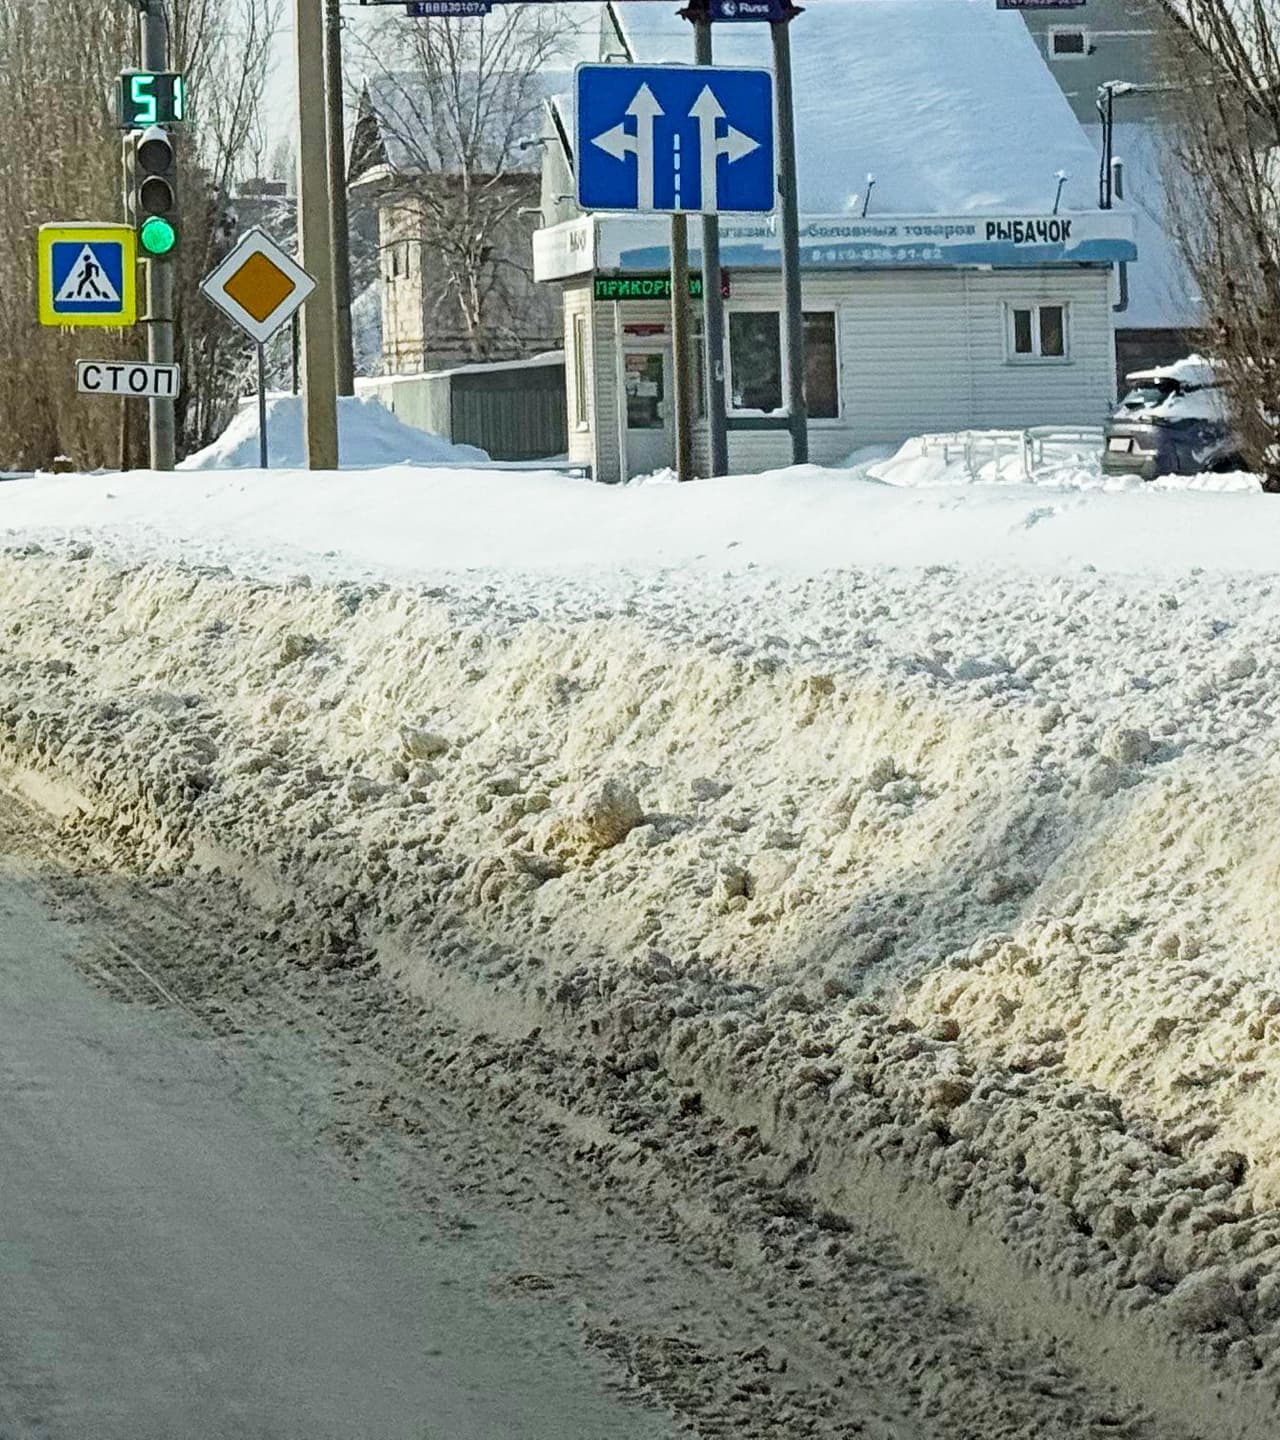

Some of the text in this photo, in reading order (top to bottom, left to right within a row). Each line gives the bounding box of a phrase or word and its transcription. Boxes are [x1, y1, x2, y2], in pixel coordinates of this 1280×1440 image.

[131, 75, 182, 122] 51
[986, 219, 1072, 244] РЫБАЧОК
[83, 365, 172, 394] СТОП
